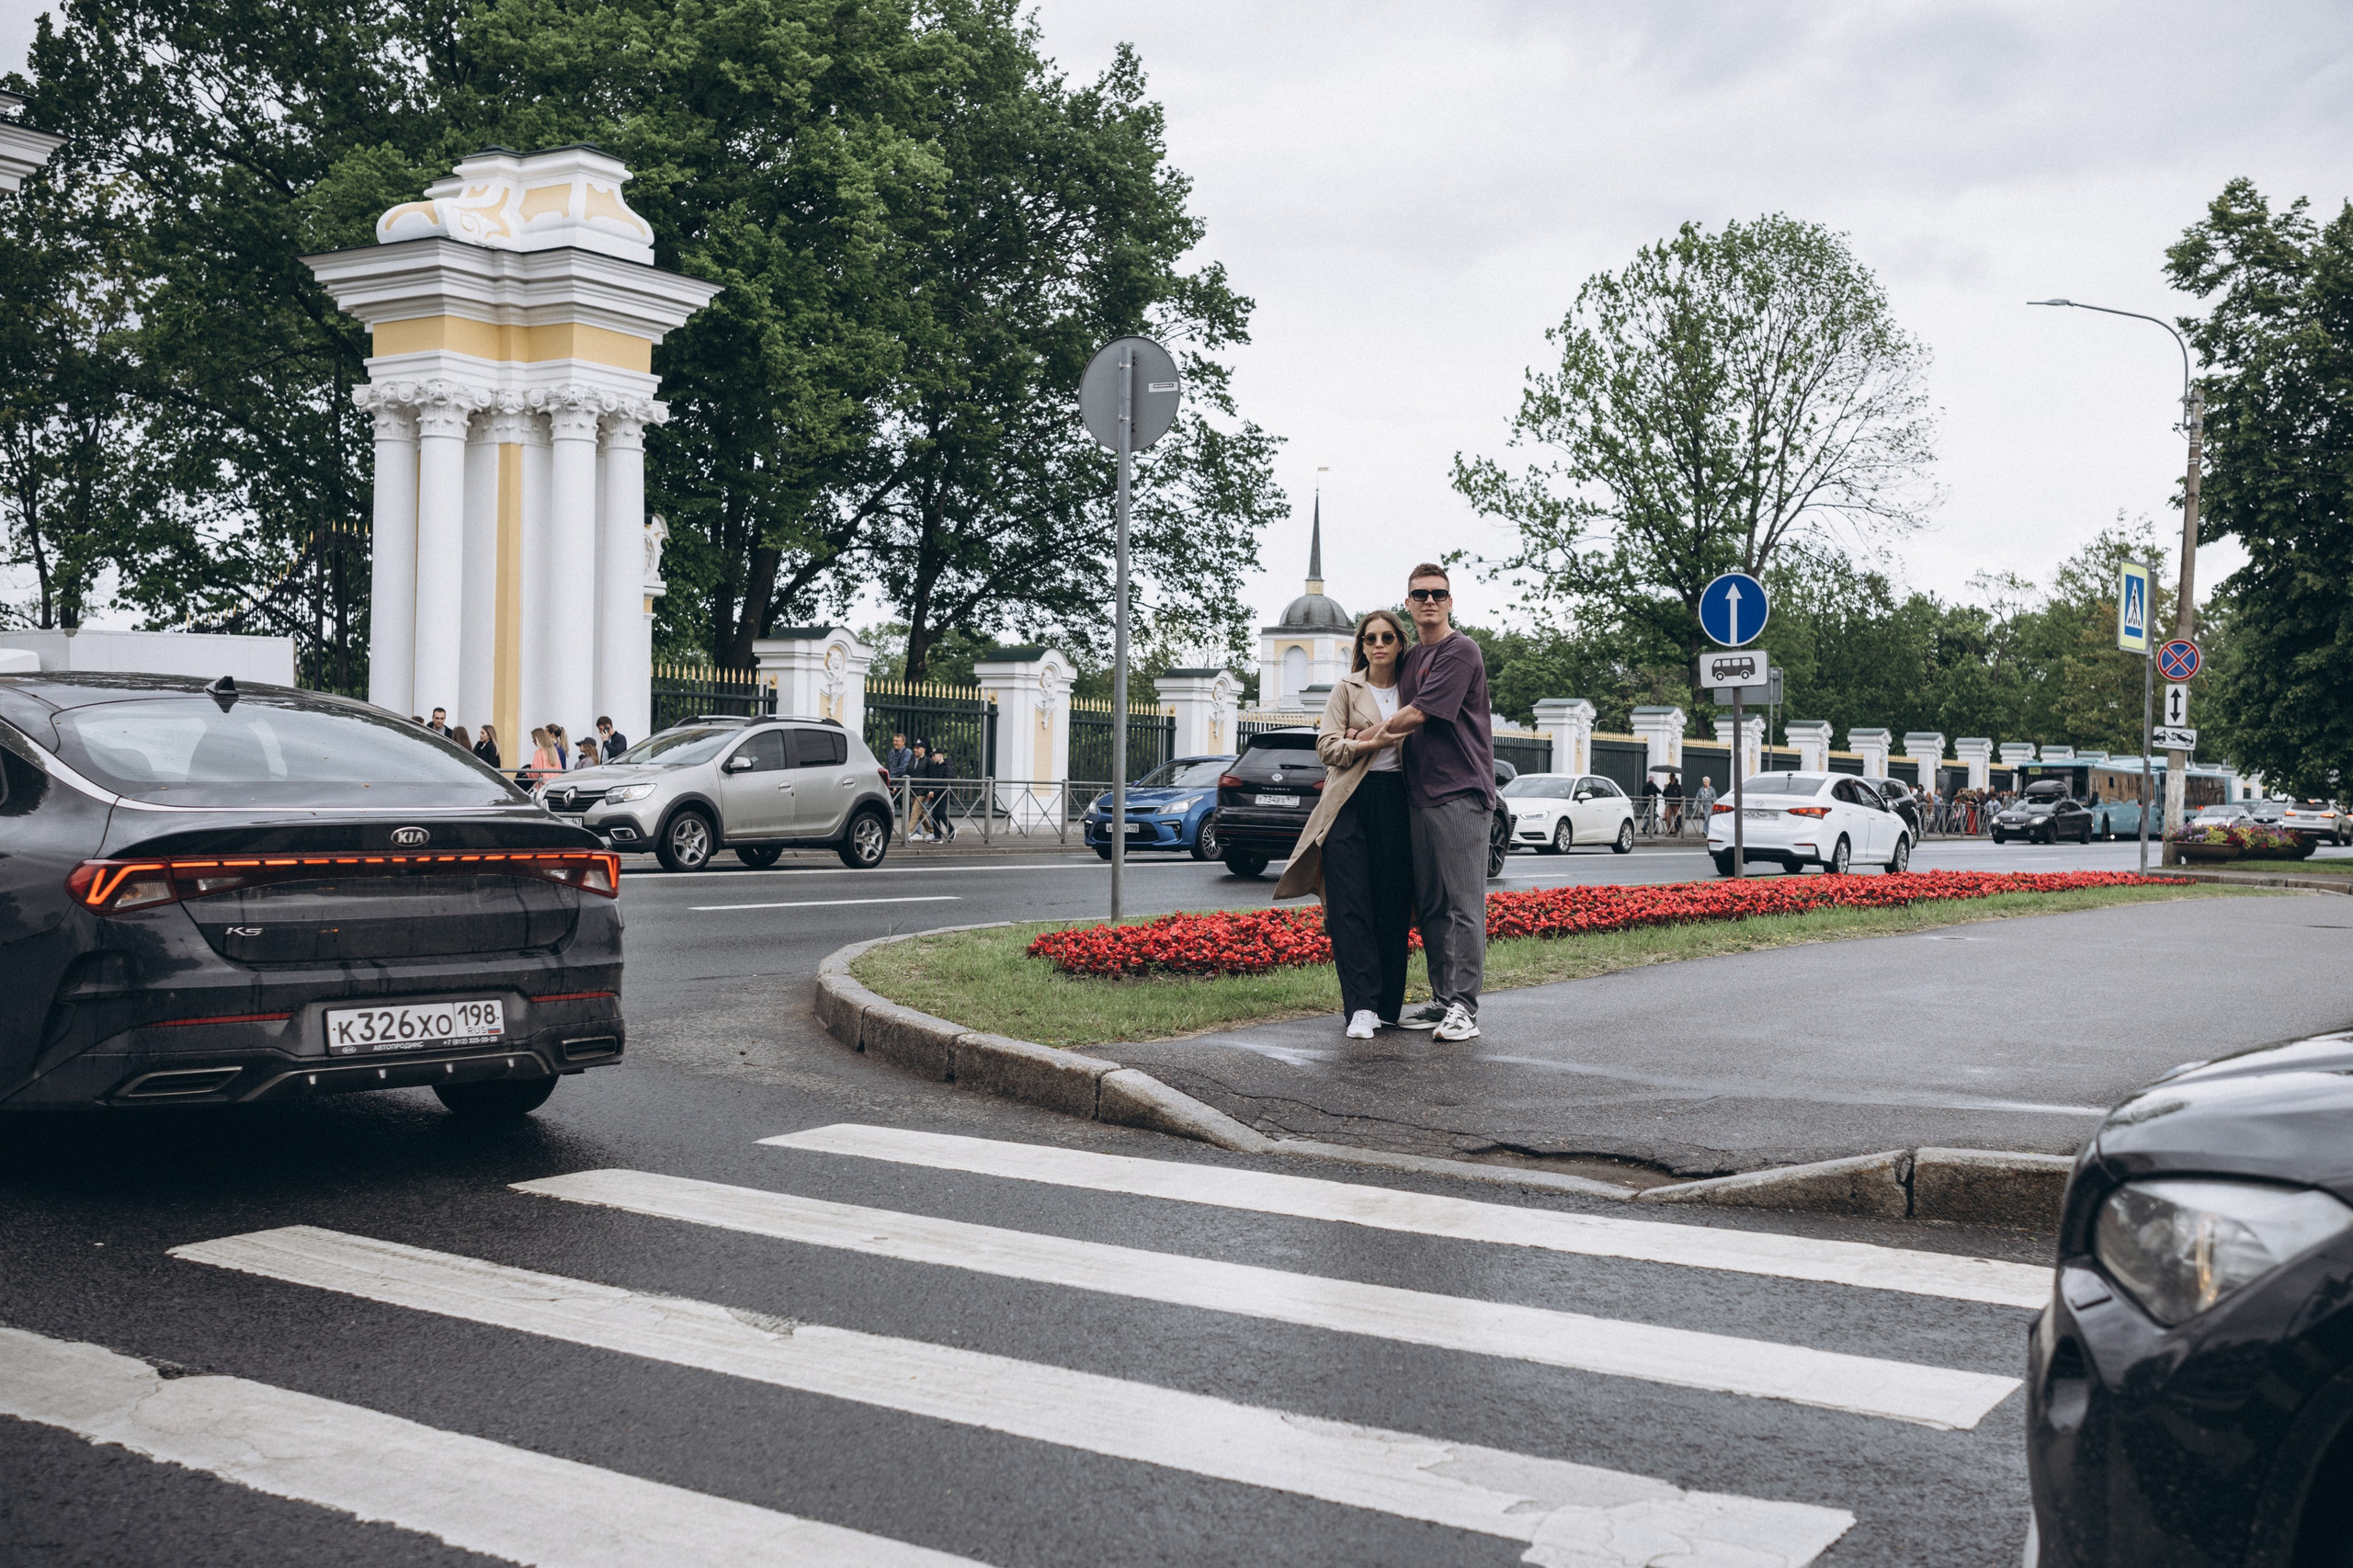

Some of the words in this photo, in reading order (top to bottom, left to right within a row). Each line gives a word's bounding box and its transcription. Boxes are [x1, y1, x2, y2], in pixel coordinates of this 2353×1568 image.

[397, 831, 424, 844] KIA
[225, 926, 263, 936] K5
[458, 1004, 495, 1026] 198
[468, 1026, 487, 1035] RUS
[373, 1040, 424, 1051] АВТОПРОДИКС
